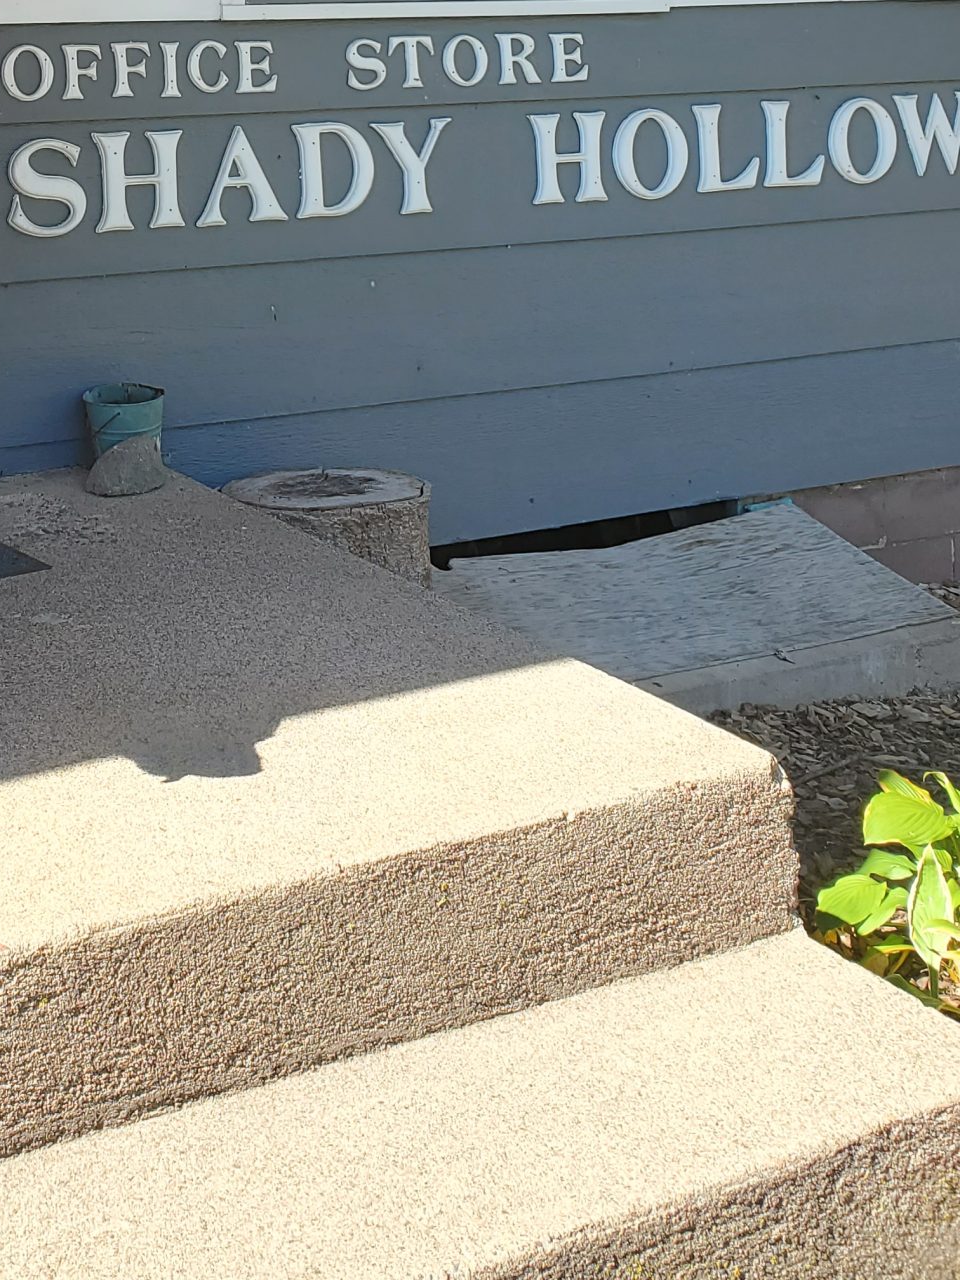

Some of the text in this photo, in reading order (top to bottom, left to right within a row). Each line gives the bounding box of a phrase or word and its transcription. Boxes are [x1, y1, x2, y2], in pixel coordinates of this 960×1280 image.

[1, 33, 589, 102] OFFICE STORE
[7, 91, 960, 238] SHADY HOLLOW
